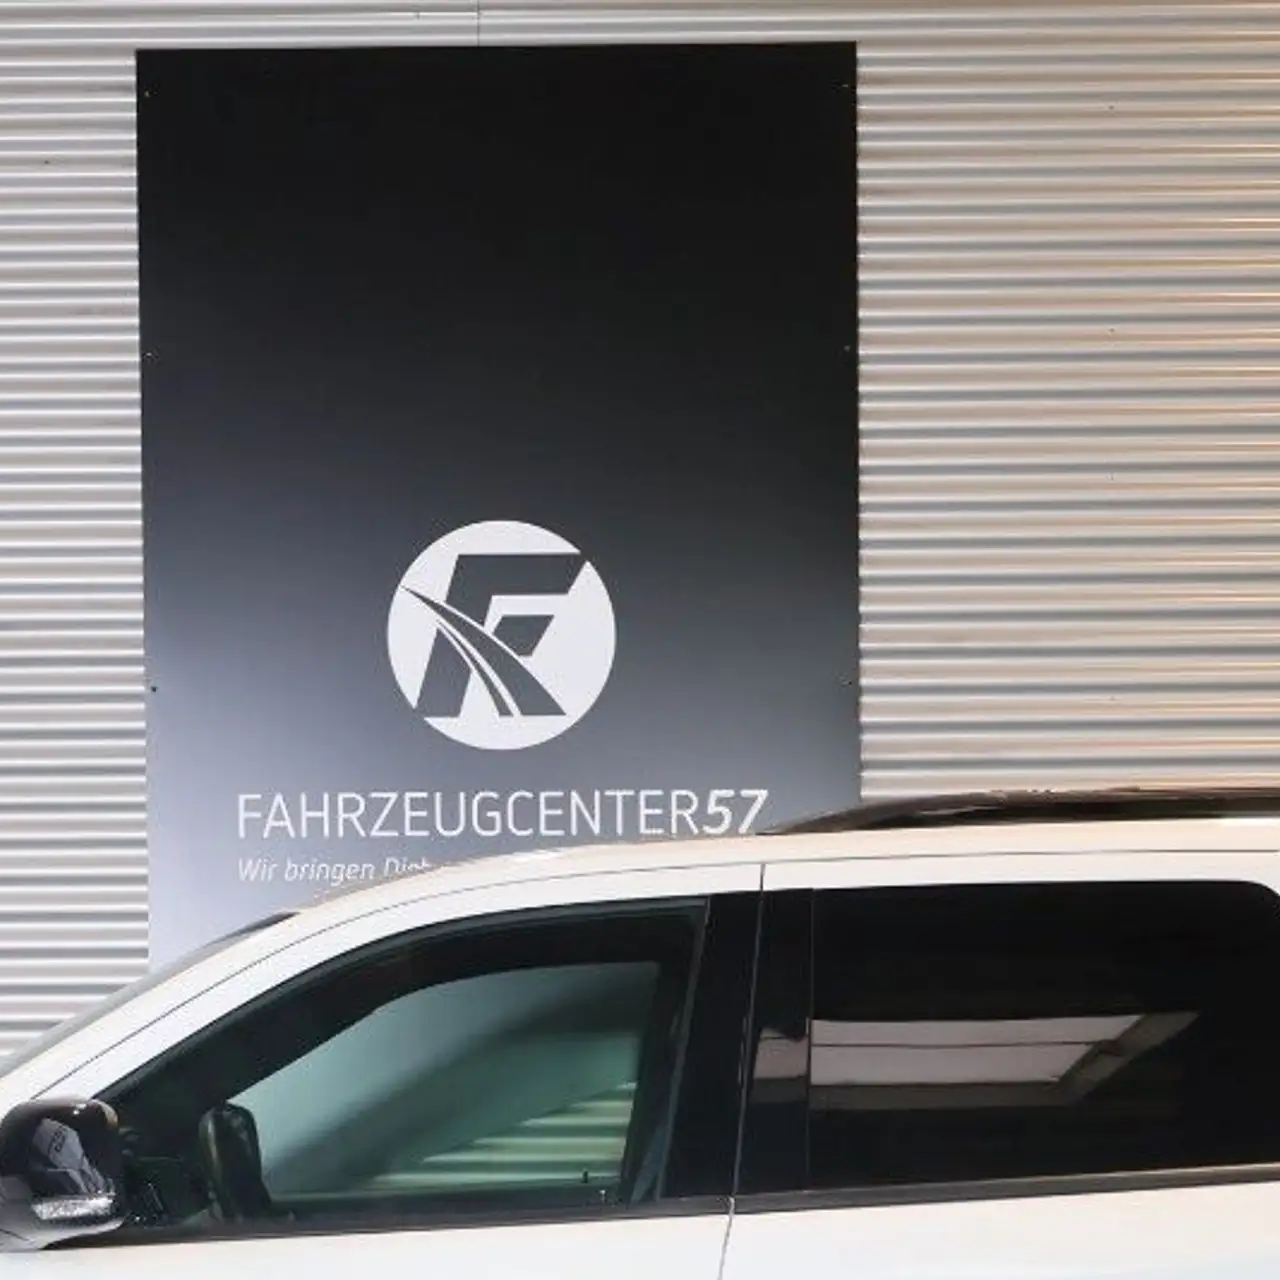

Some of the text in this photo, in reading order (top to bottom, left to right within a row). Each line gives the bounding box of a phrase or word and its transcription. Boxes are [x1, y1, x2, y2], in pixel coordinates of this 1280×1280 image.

[237, 789, 769, 839] FAHRZEUGCENTER57
[238, 857, 277, 882] Wir
[284, 856, 375, 886] bringen
